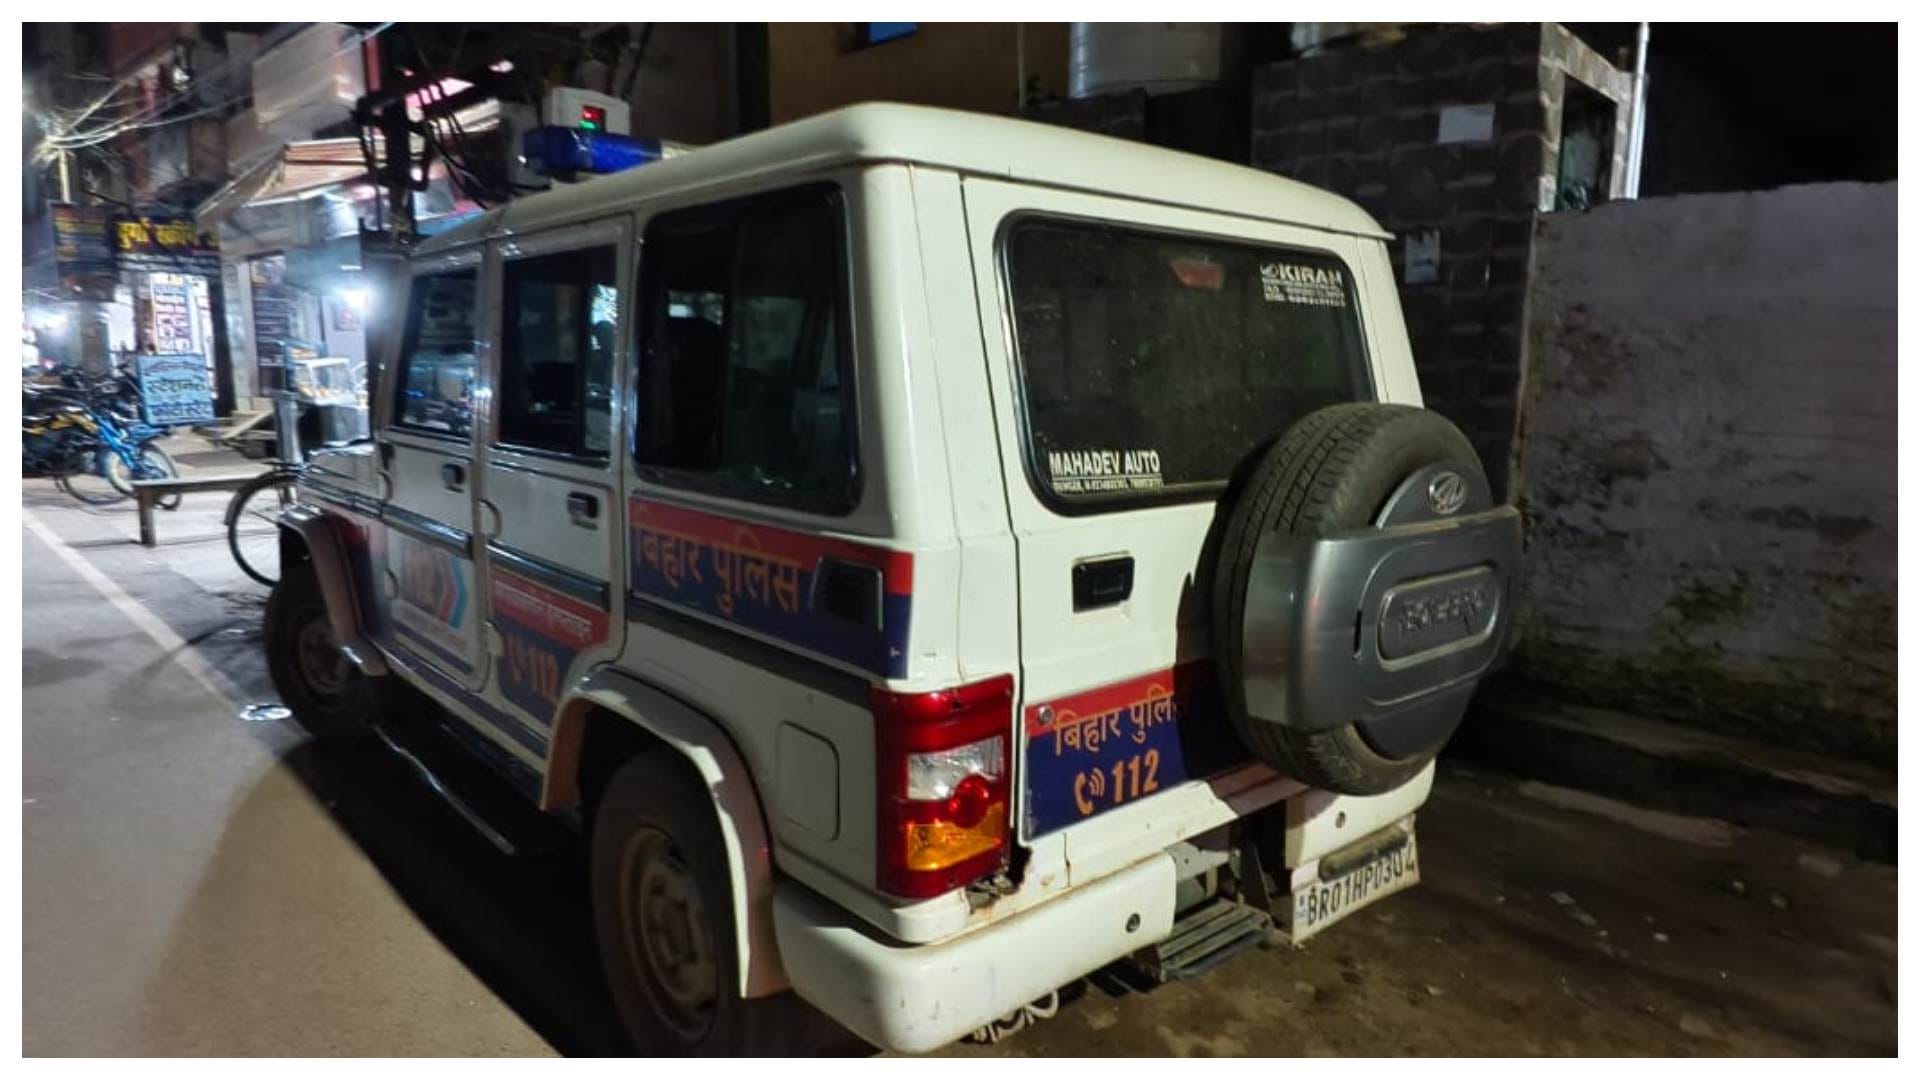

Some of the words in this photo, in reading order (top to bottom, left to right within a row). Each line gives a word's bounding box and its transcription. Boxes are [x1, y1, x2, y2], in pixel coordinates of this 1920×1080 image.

[1048, 451, 1119, 476] MAHADEV
[1124, 449, 1160, 474] AUTO
[630, 503, 703, 588] बिहार
[708, 525, 801, 617] पुलिस
[1055, 707, 1122, 756] बिहार
[1128, 684, 1177, 744] पुलि
[1112, 748, 1160, 804] 112
